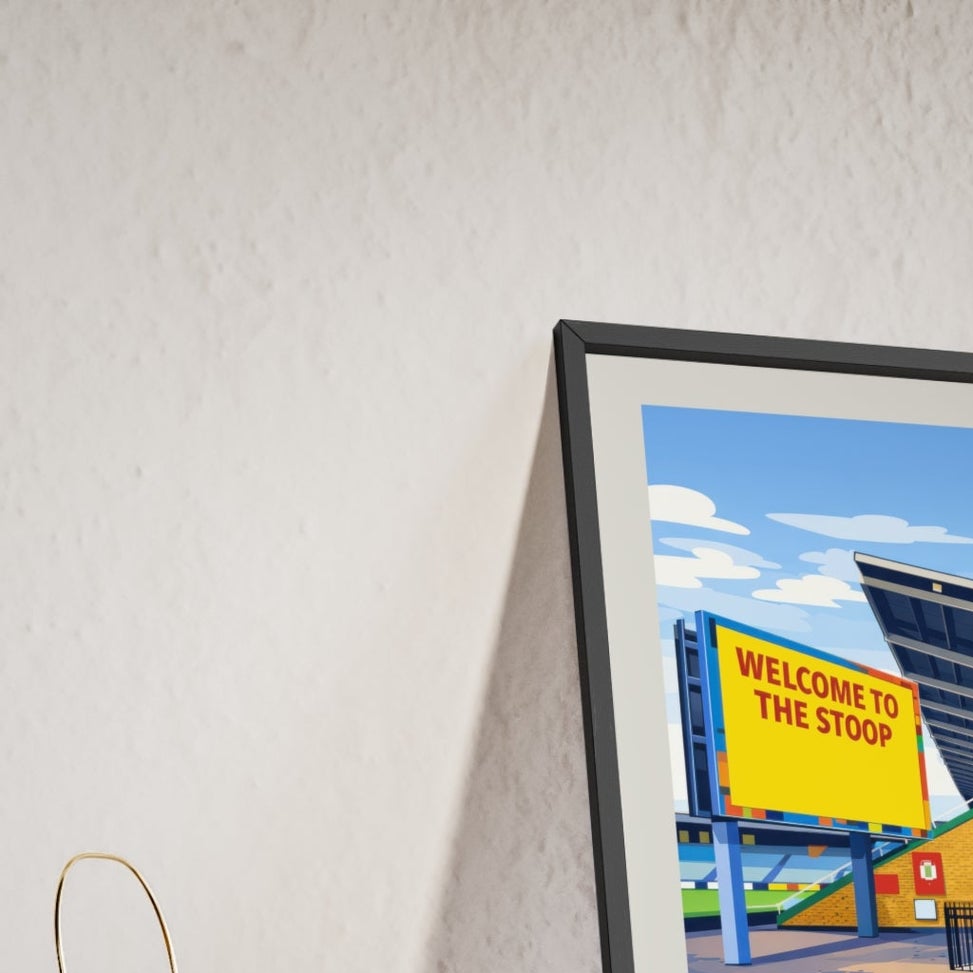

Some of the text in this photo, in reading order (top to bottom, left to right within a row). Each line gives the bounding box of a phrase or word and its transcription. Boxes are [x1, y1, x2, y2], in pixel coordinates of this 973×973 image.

[736, 646, 899, 719] WELCOME TO
[753, 689, 893, 748] THE STOOP
